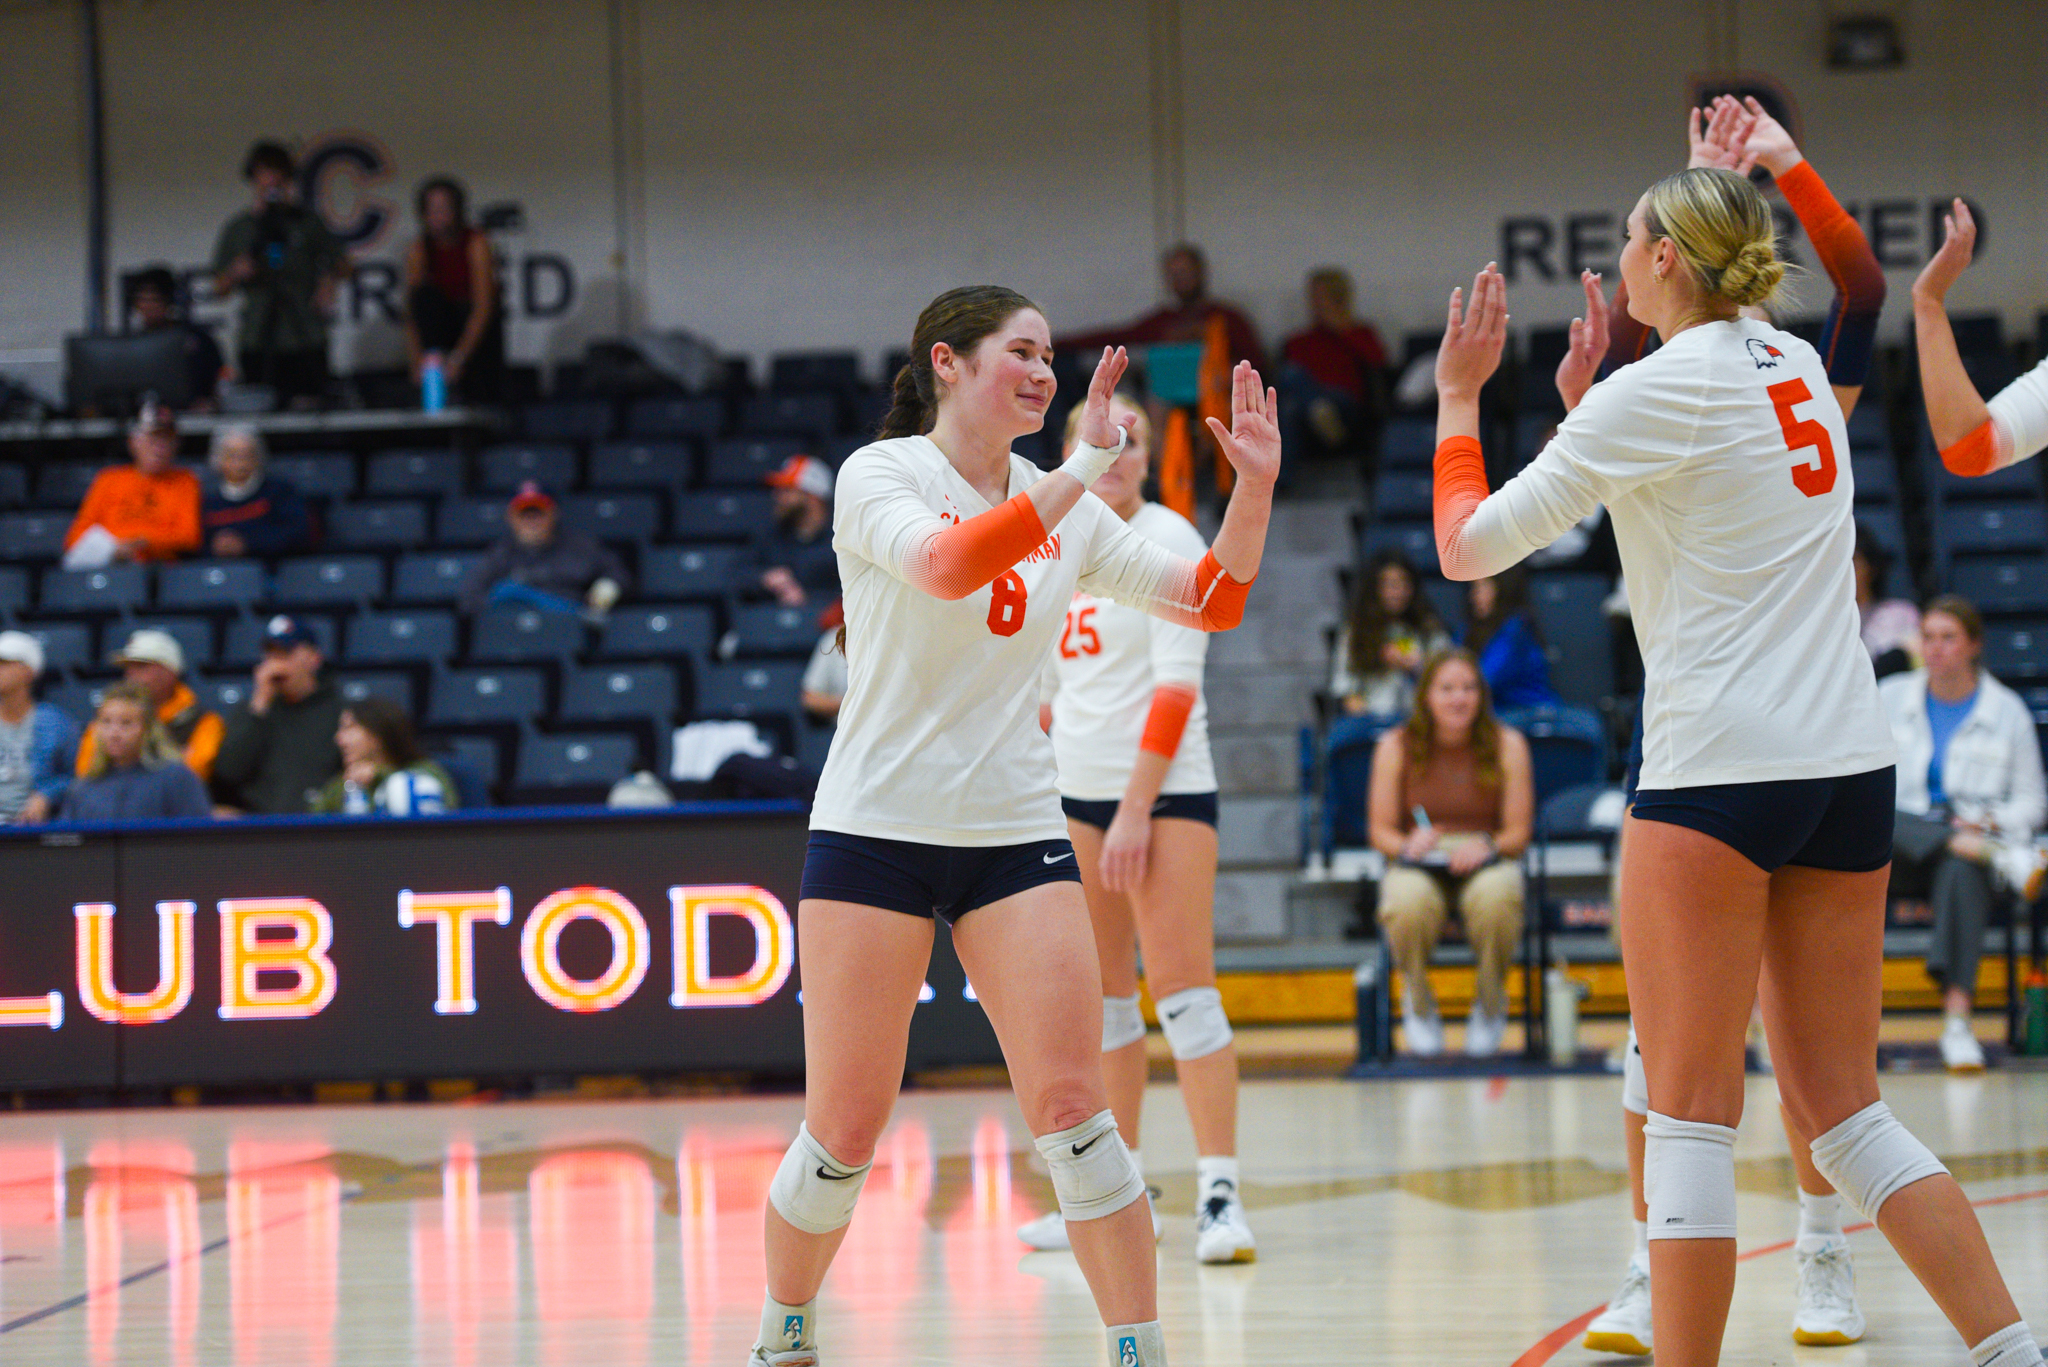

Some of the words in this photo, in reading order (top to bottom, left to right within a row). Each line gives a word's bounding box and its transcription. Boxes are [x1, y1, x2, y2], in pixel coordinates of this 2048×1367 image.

[1766, 377, 1838, 498] 5
[986, 568, 1028, 637] 8
[1060, 607, 1101, 659] 25
[398, 884, 980, 1016] TOD
